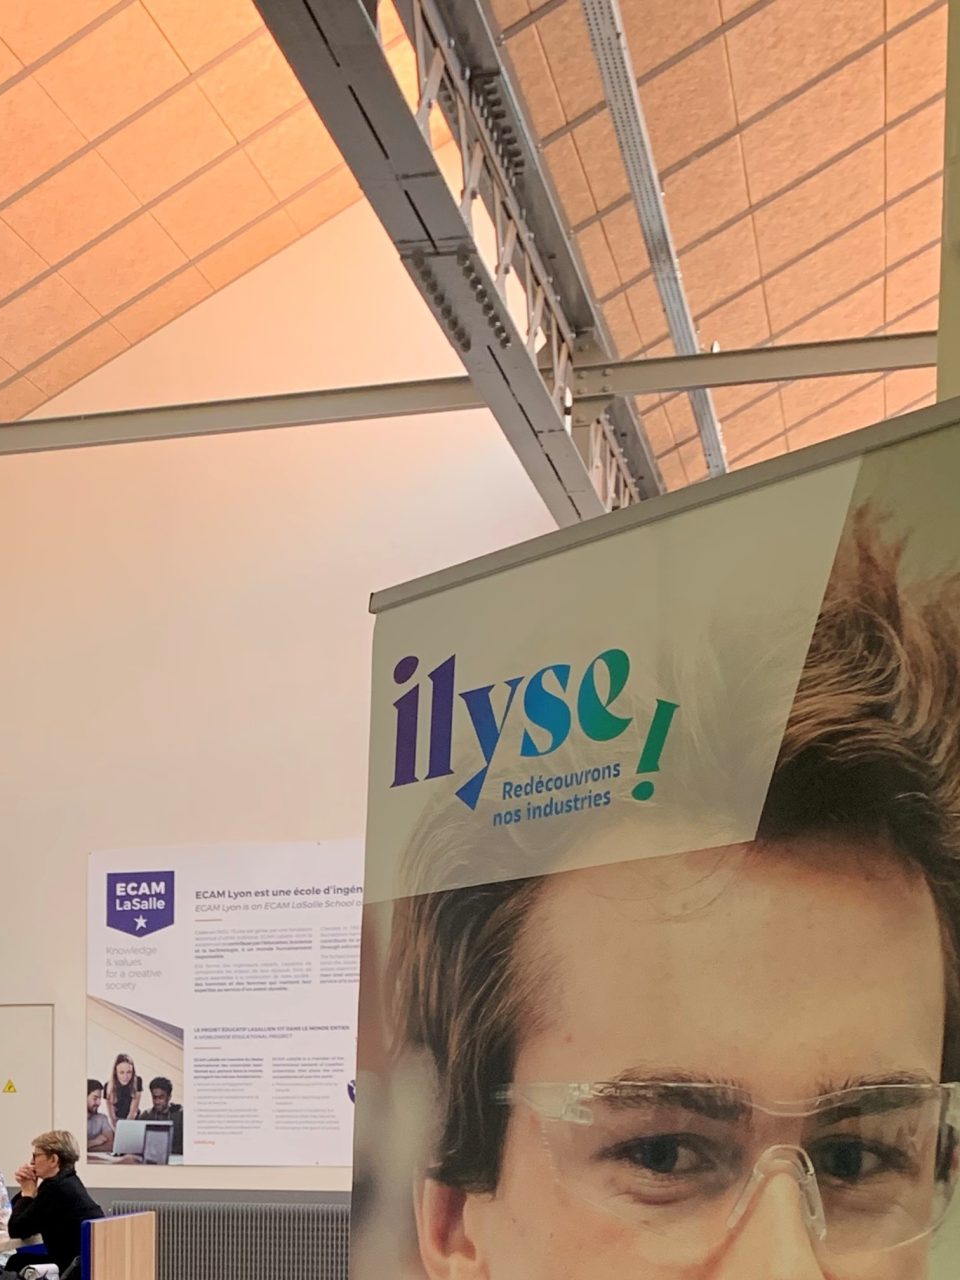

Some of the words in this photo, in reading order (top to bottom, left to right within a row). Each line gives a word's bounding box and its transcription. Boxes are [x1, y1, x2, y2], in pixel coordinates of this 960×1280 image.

[502, 761, 621, 800] Redécouvrons
[493, 807, 521, 826] nos
[527, 788, 611, 821] industries
[115, 881, 166, 896] ECAM
[195, 889, 226, 900] ECAM
[228, 889, 252, 901] Lyon
[254, 889, 270, 898] est
[272, 889, 292, 897] une
[293, 886, 321, 896] école
[115, 897, 166, 911] LaSalle
[195, 903, 221, 913] ECAM
[222, 902, 241, 913] Lyon
[243, 902, 250, 911] is
[264, 901, 291, 911] ECAM
[292, 900, 324, 910] LaSalle
[325, 899, 354, 908] School
